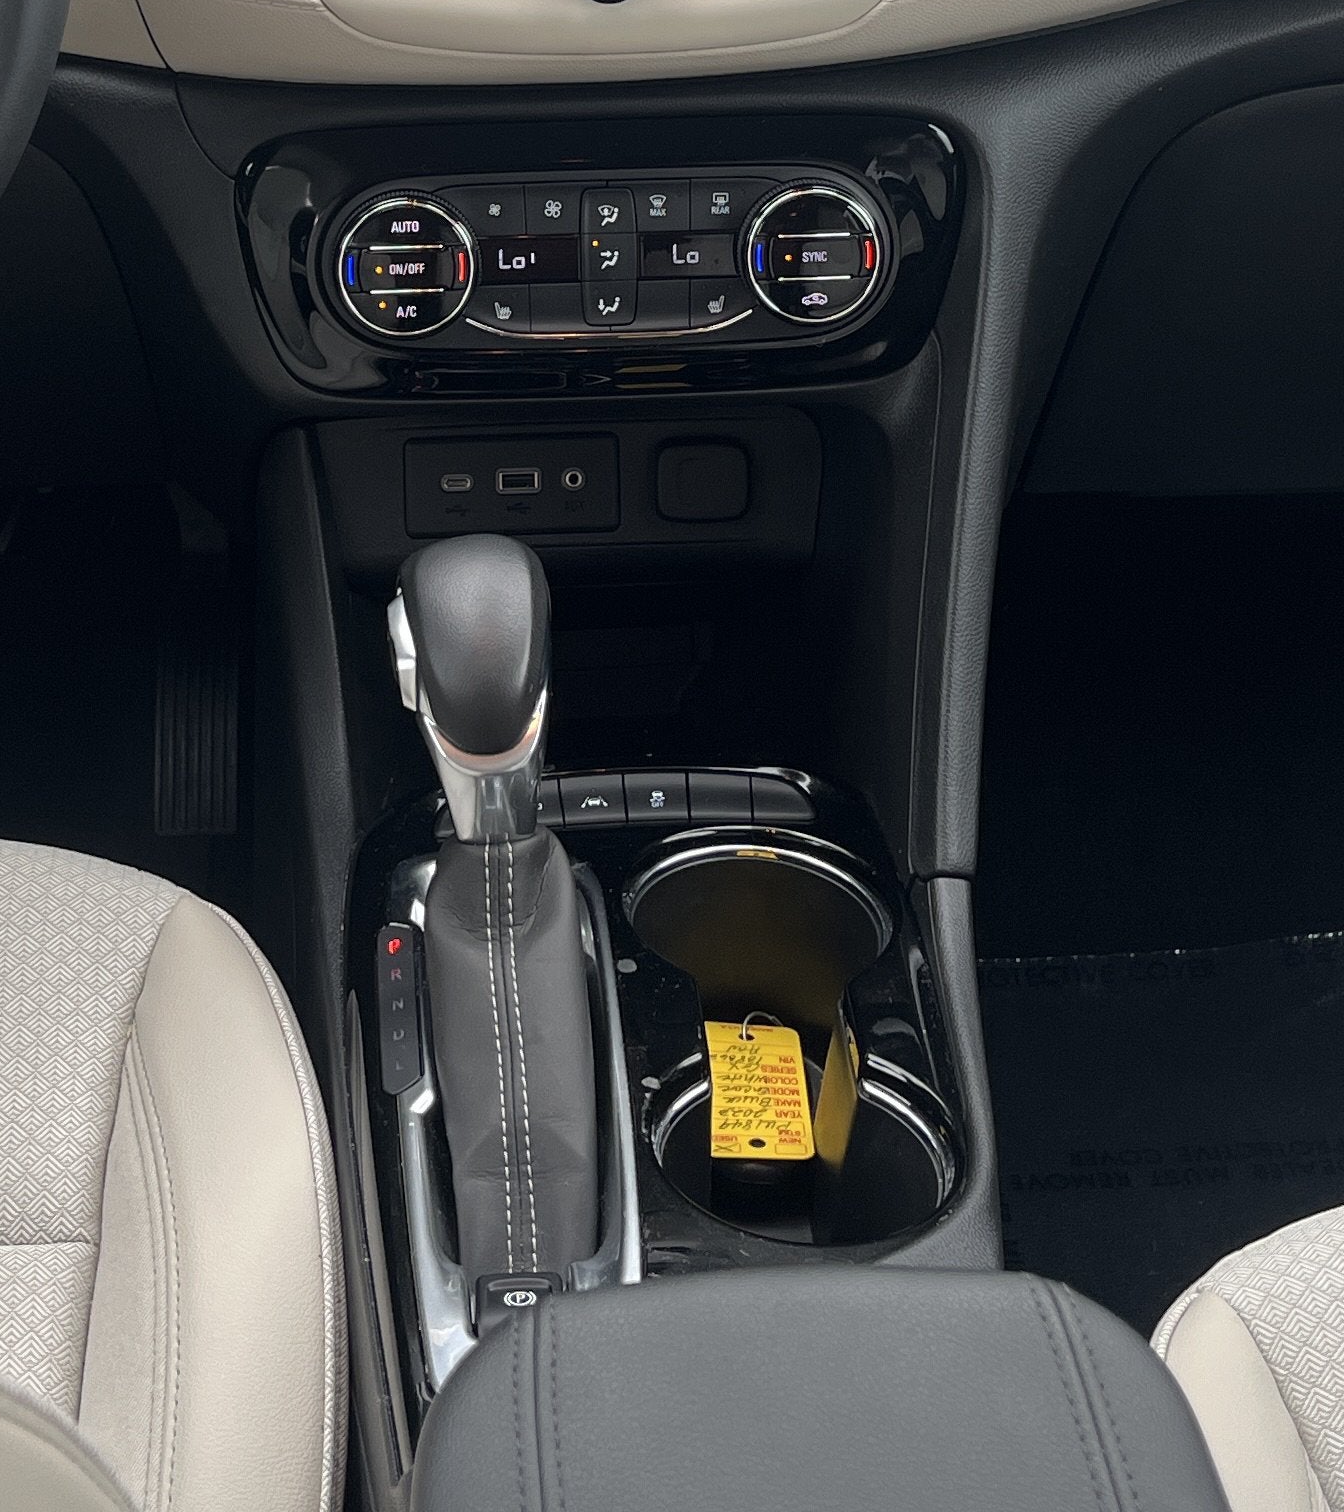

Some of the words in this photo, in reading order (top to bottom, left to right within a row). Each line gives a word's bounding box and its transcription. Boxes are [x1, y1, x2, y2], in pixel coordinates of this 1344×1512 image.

[649, 208, 667, 217] MAX
[711, 205, 730, 215] REAR
[390, 220, 420, 234] AUTO
[802, 251, 828, 263] SYNC
[389, 262, 426, 276] ON/OFF
[396, 305, 418, 319] A/C
[387, 938, 401, 955] P
[390, 967, 403, 982] R
[392, 998, 404, 1012] N
[774, 1098, 802, 1107] MAKE
[775, 1110, 803, 1119] YEAR
